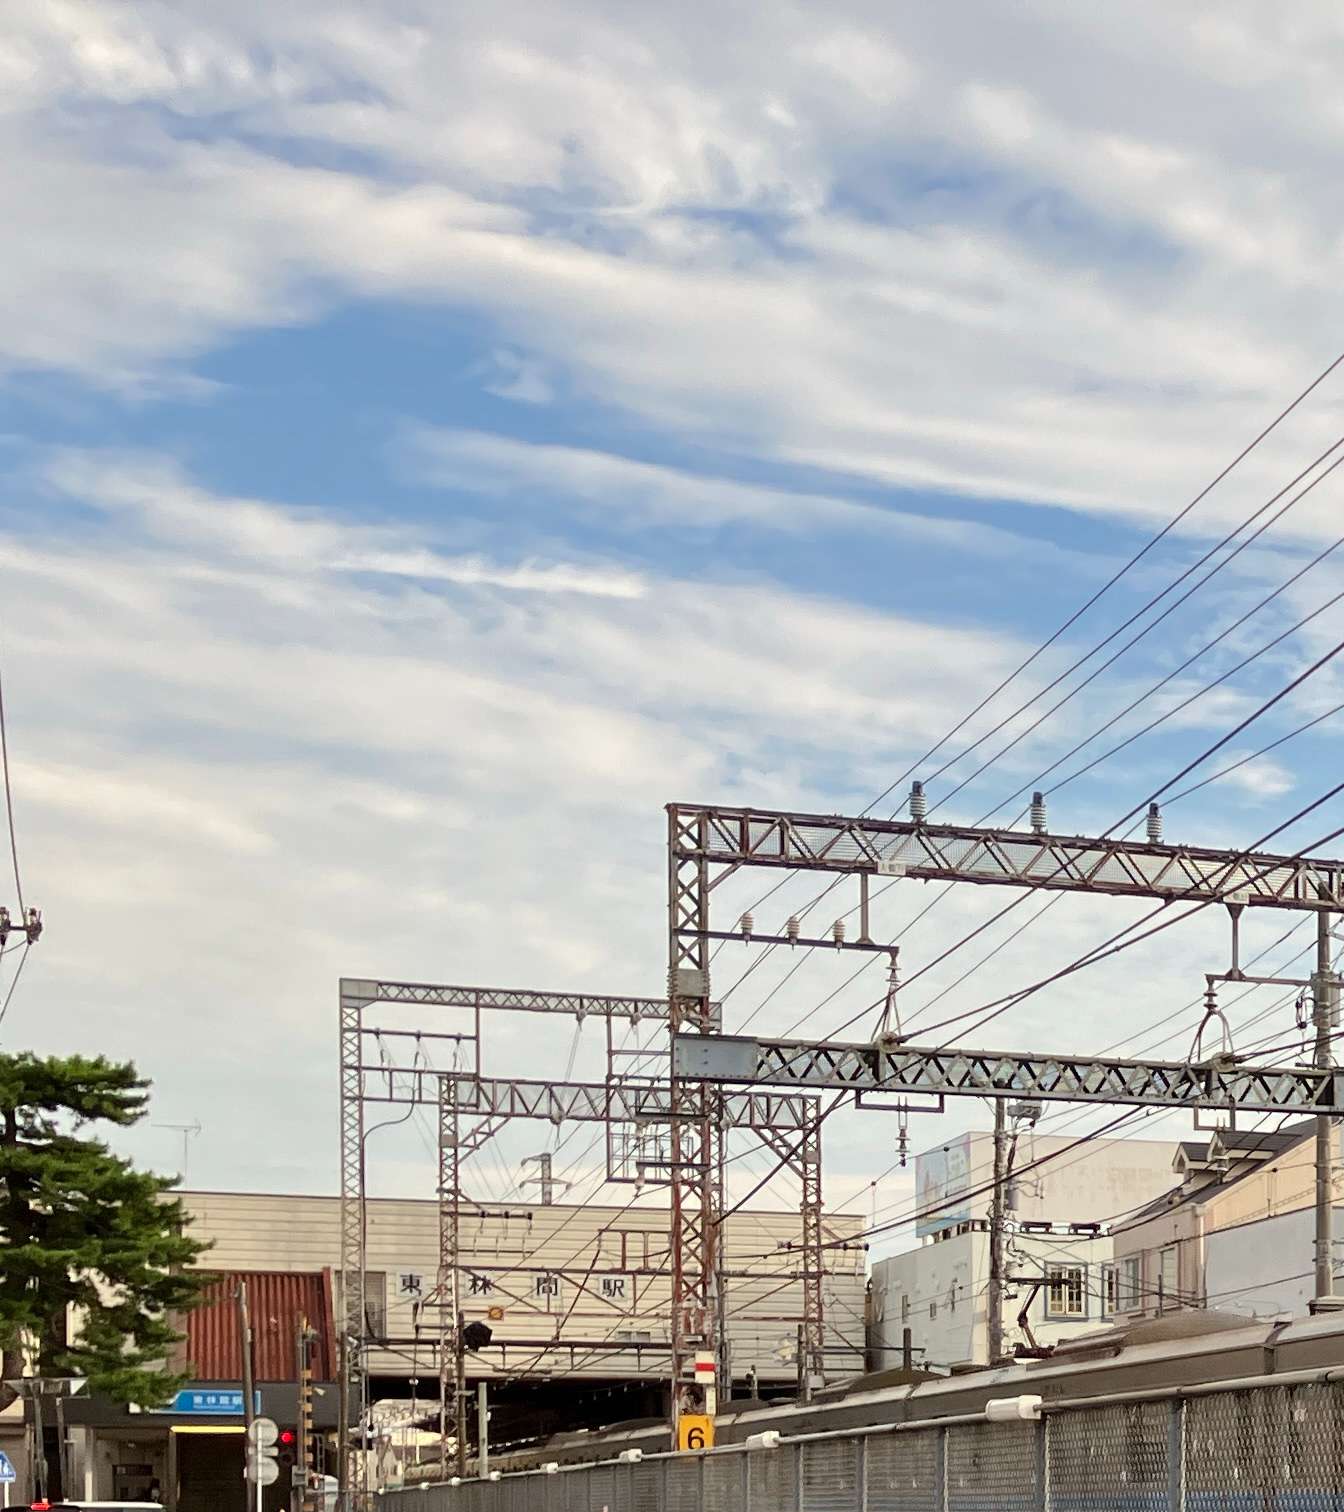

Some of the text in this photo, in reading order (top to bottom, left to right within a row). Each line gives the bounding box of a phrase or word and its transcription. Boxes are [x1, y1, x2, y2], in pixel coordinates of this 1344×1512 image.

[401, 1274, 625, 1298] 東林間駅
[687, 1427, 705, 1450] 6
